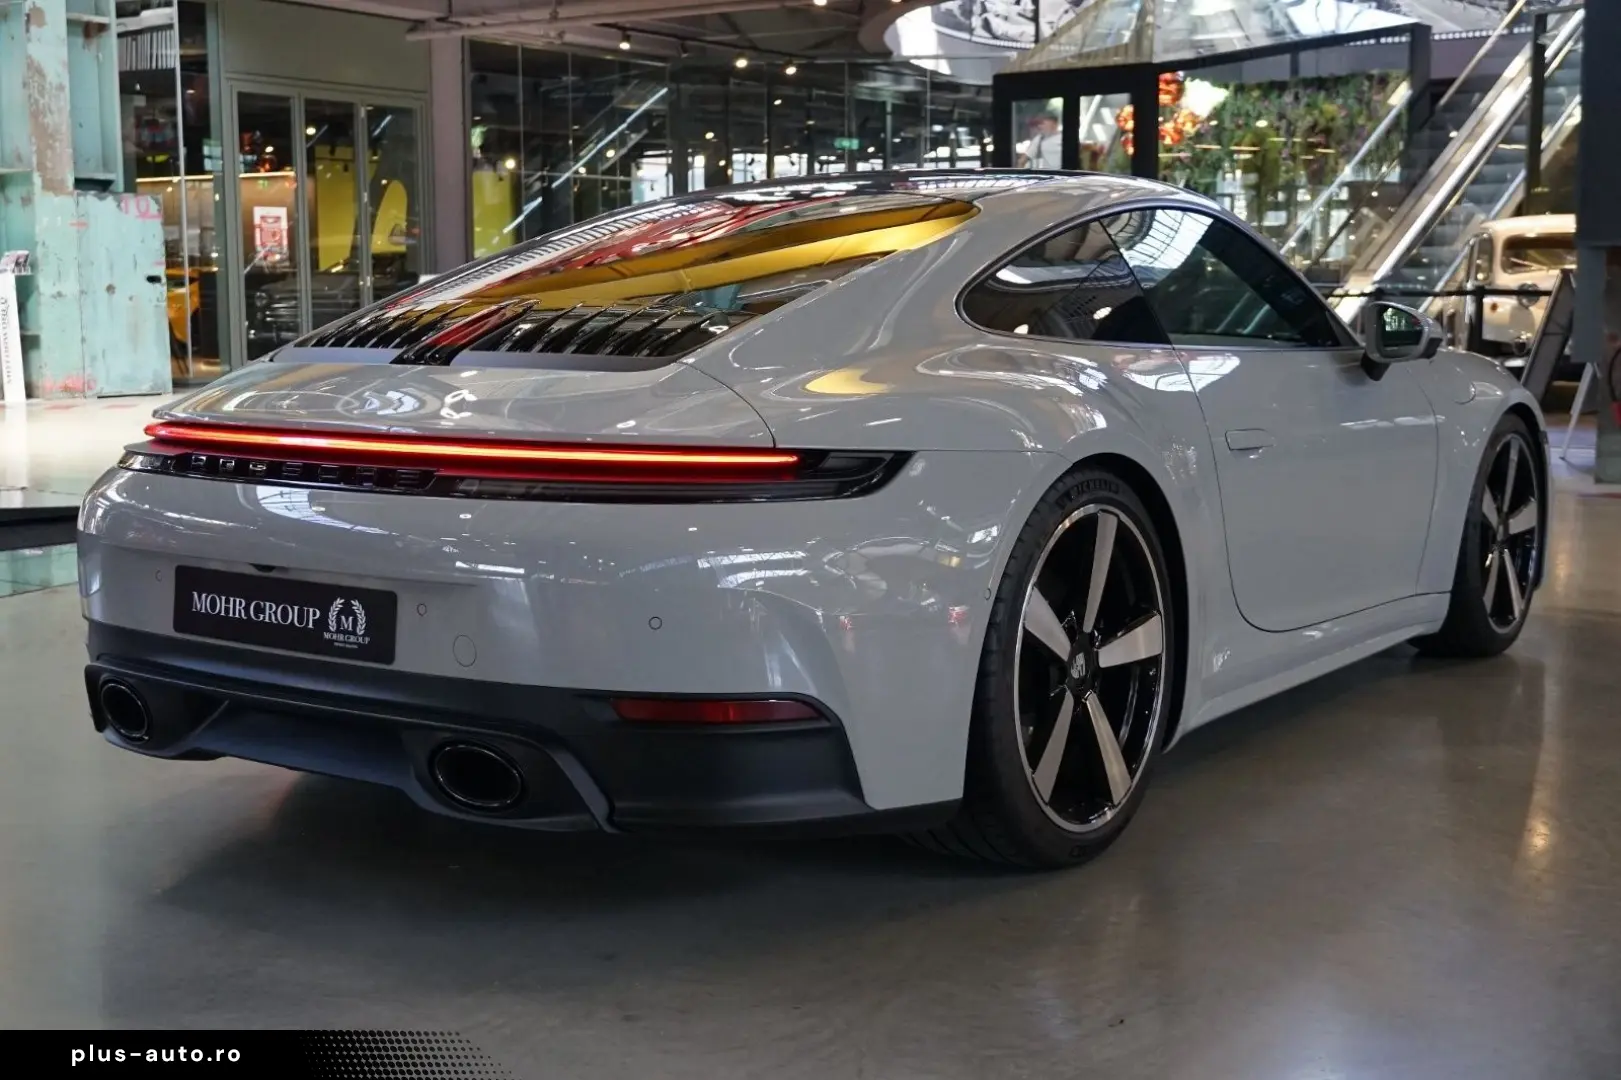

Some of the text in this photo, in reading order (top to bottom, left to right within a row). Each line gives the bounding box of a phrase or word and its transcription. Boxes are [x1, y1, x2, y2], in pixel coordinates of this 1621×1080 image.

[191, 591, 321, 629] MOHR GROUP
[340, 615, 354, 631] M
[323, 631, 371, 645] MOHR GROUP
